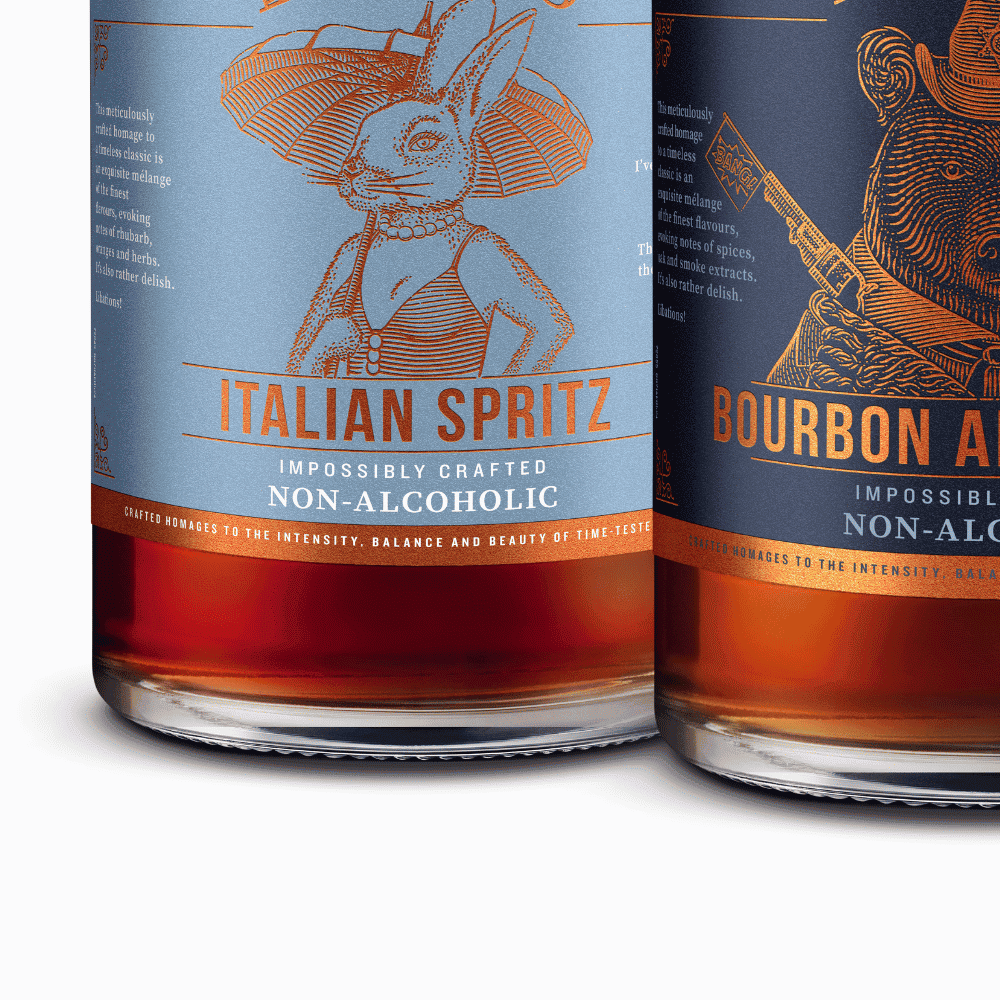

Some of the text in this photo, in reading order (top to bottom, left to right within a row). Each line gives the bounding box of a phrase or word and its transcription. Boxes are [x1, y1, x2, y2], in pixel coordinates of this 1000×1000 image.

[106, 105, 154, 126] meticulously
[667, 103, 714, 125] meticulously
[113, 124, 143, 144] homage
[146, 131, 155, 143] to
[674, 124, 703, 145] homage
[123, 146, 152, 163] classic
[154, 151, 164, 165] is
[666, 145, 697, 163] timeless
[676, 167, 682, 182] is
[684, 172, 694, 184] an
[714, 145, 758, 191] BANG!
[132, 169, 172, 189] mélange
[684, 192, 723, 213] mélange
[118, 208, 151, 228] evoking
[672, 210, 694, 228] finest
[695, 215, 739, 239] flavours,
[116, 227, 153, 248] rhubarb,
[116, 248, 130, 261] and
[131, 249, 160, 267] herbs.
[679, 238, 702, 251] notes
[704, 239, 715, 253] of
[716, 243, 755, 263] spices,
[115, 268, 139, 283] rather
[141, 272, 175, 290] delish.
[679, 258, 706, 274] smoke
[708, 266, 757, 283] extracts.
[678, 279, 705, 295] rather
[706, 283, 743, 302] delish.
[220, 379, 413, 443] ITALIAN
[437, 376, 611, 443] SPRITZ
[713, 385, 930, 466] BOURBON
[279, 459, 547, 479] IMPOSSIBLY CRAFTED
[267, 485, 559, 514] NON-ALCOHOLIC
[124, 506, 161, 524] CRAFTED
[165, 516, 217, 534] HOMAGES
[224, 525, 239, 537] TO
[246, 528, 269, 540] THE
[372, 537, 443, 548] BALANCE
[451, 537, 480, 547] AND
[489, 533, 547, 547] BEAUTY
[553, 531, 570, 543] OF
[688, 534, 728, 555] CRAFTED
[733, 545, 789, 565] HOMAGES
[795, 556, 811, 568] TO
[819, 558, 845, 572] THE
